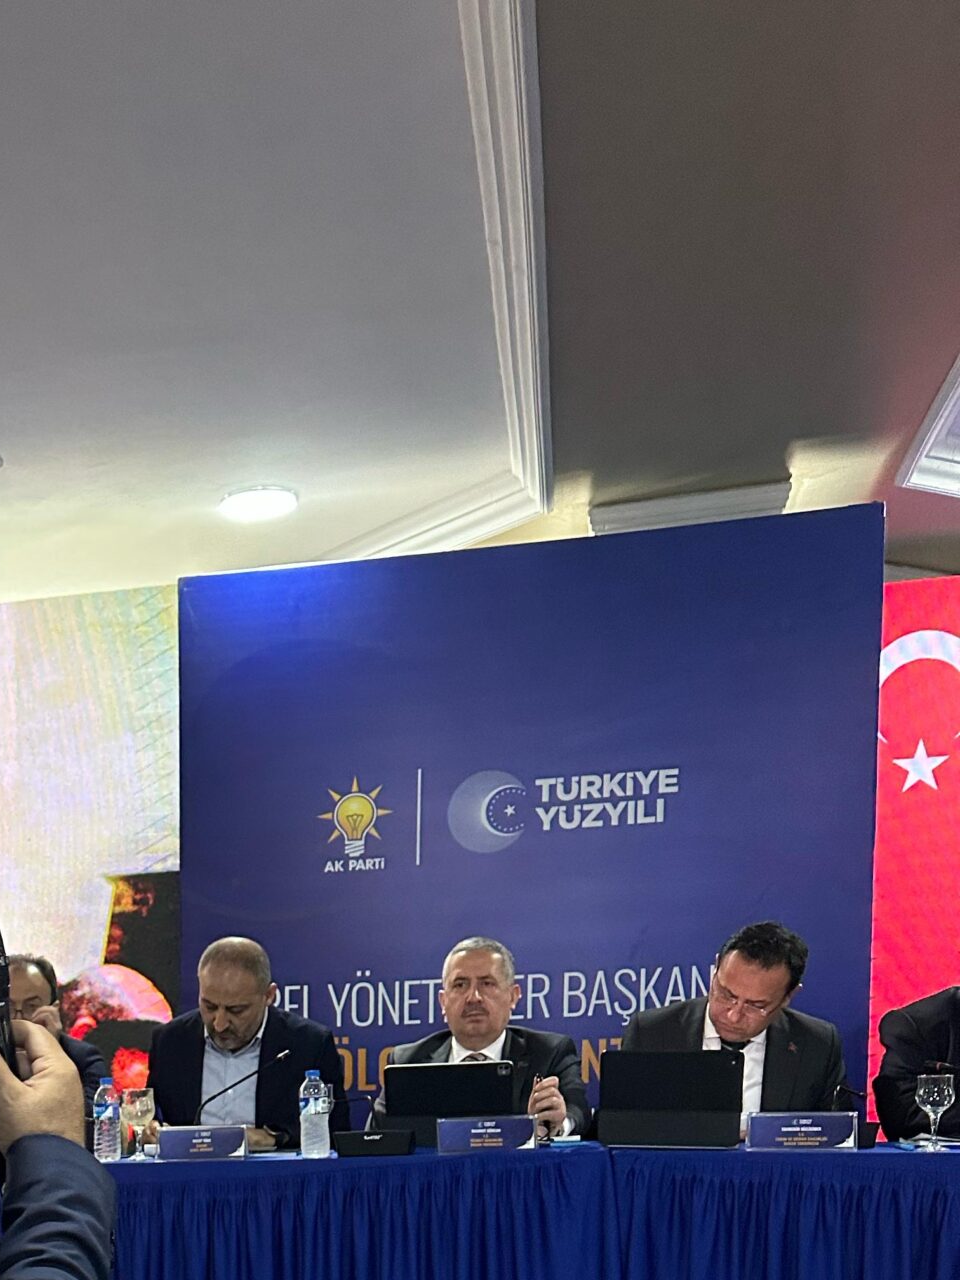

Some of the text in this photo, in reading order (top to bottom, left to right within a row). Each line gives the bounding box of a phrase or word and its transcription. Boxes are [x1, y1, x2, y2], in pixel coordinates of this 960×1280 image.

[535, 768, 679, 802] TÜRKİYE
[535, 798, 665, 831] YÜZYILI
[324, 860, 344, 872] AK
